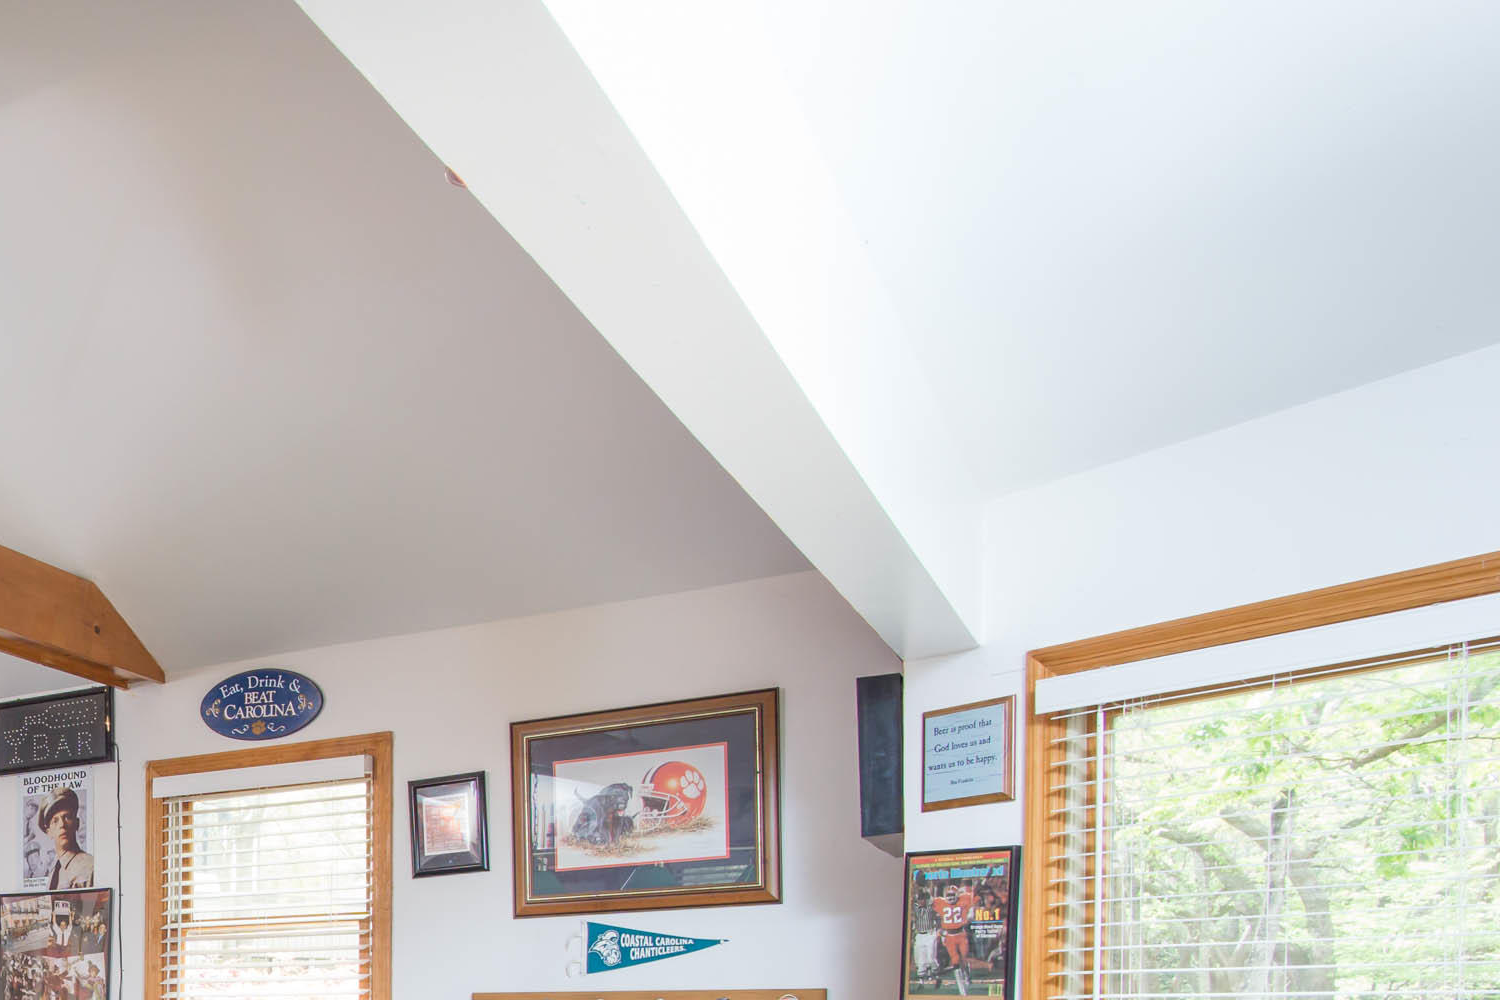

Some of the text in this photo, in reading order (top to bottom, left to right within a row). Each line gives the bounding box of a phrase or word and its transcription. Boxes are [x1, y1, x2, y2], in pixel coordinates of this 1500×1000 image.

[219, 674, 301, 699] Eat, Drink &
[244, 690, 277, 705] BEAT
[224, 700, 296, 720] CAROLINA
[933, 727, 949, 736] Beer
[957, 720, 976, 734] proof
[978, 718, 992, 727] that
[33, 732, 93, 761] BAR
[933, 742, 950, 752] God
[952, 741, 968, 750] loves
[979, 736, 991, 745] and
[966, 757, 974, 765] be
[23, 770, 87, 786] BLOODHOUND
[27, 786, 39, 794] OF
[942, 906, 963, 923] 22
[620, 933, 653, 948] COASTAL
